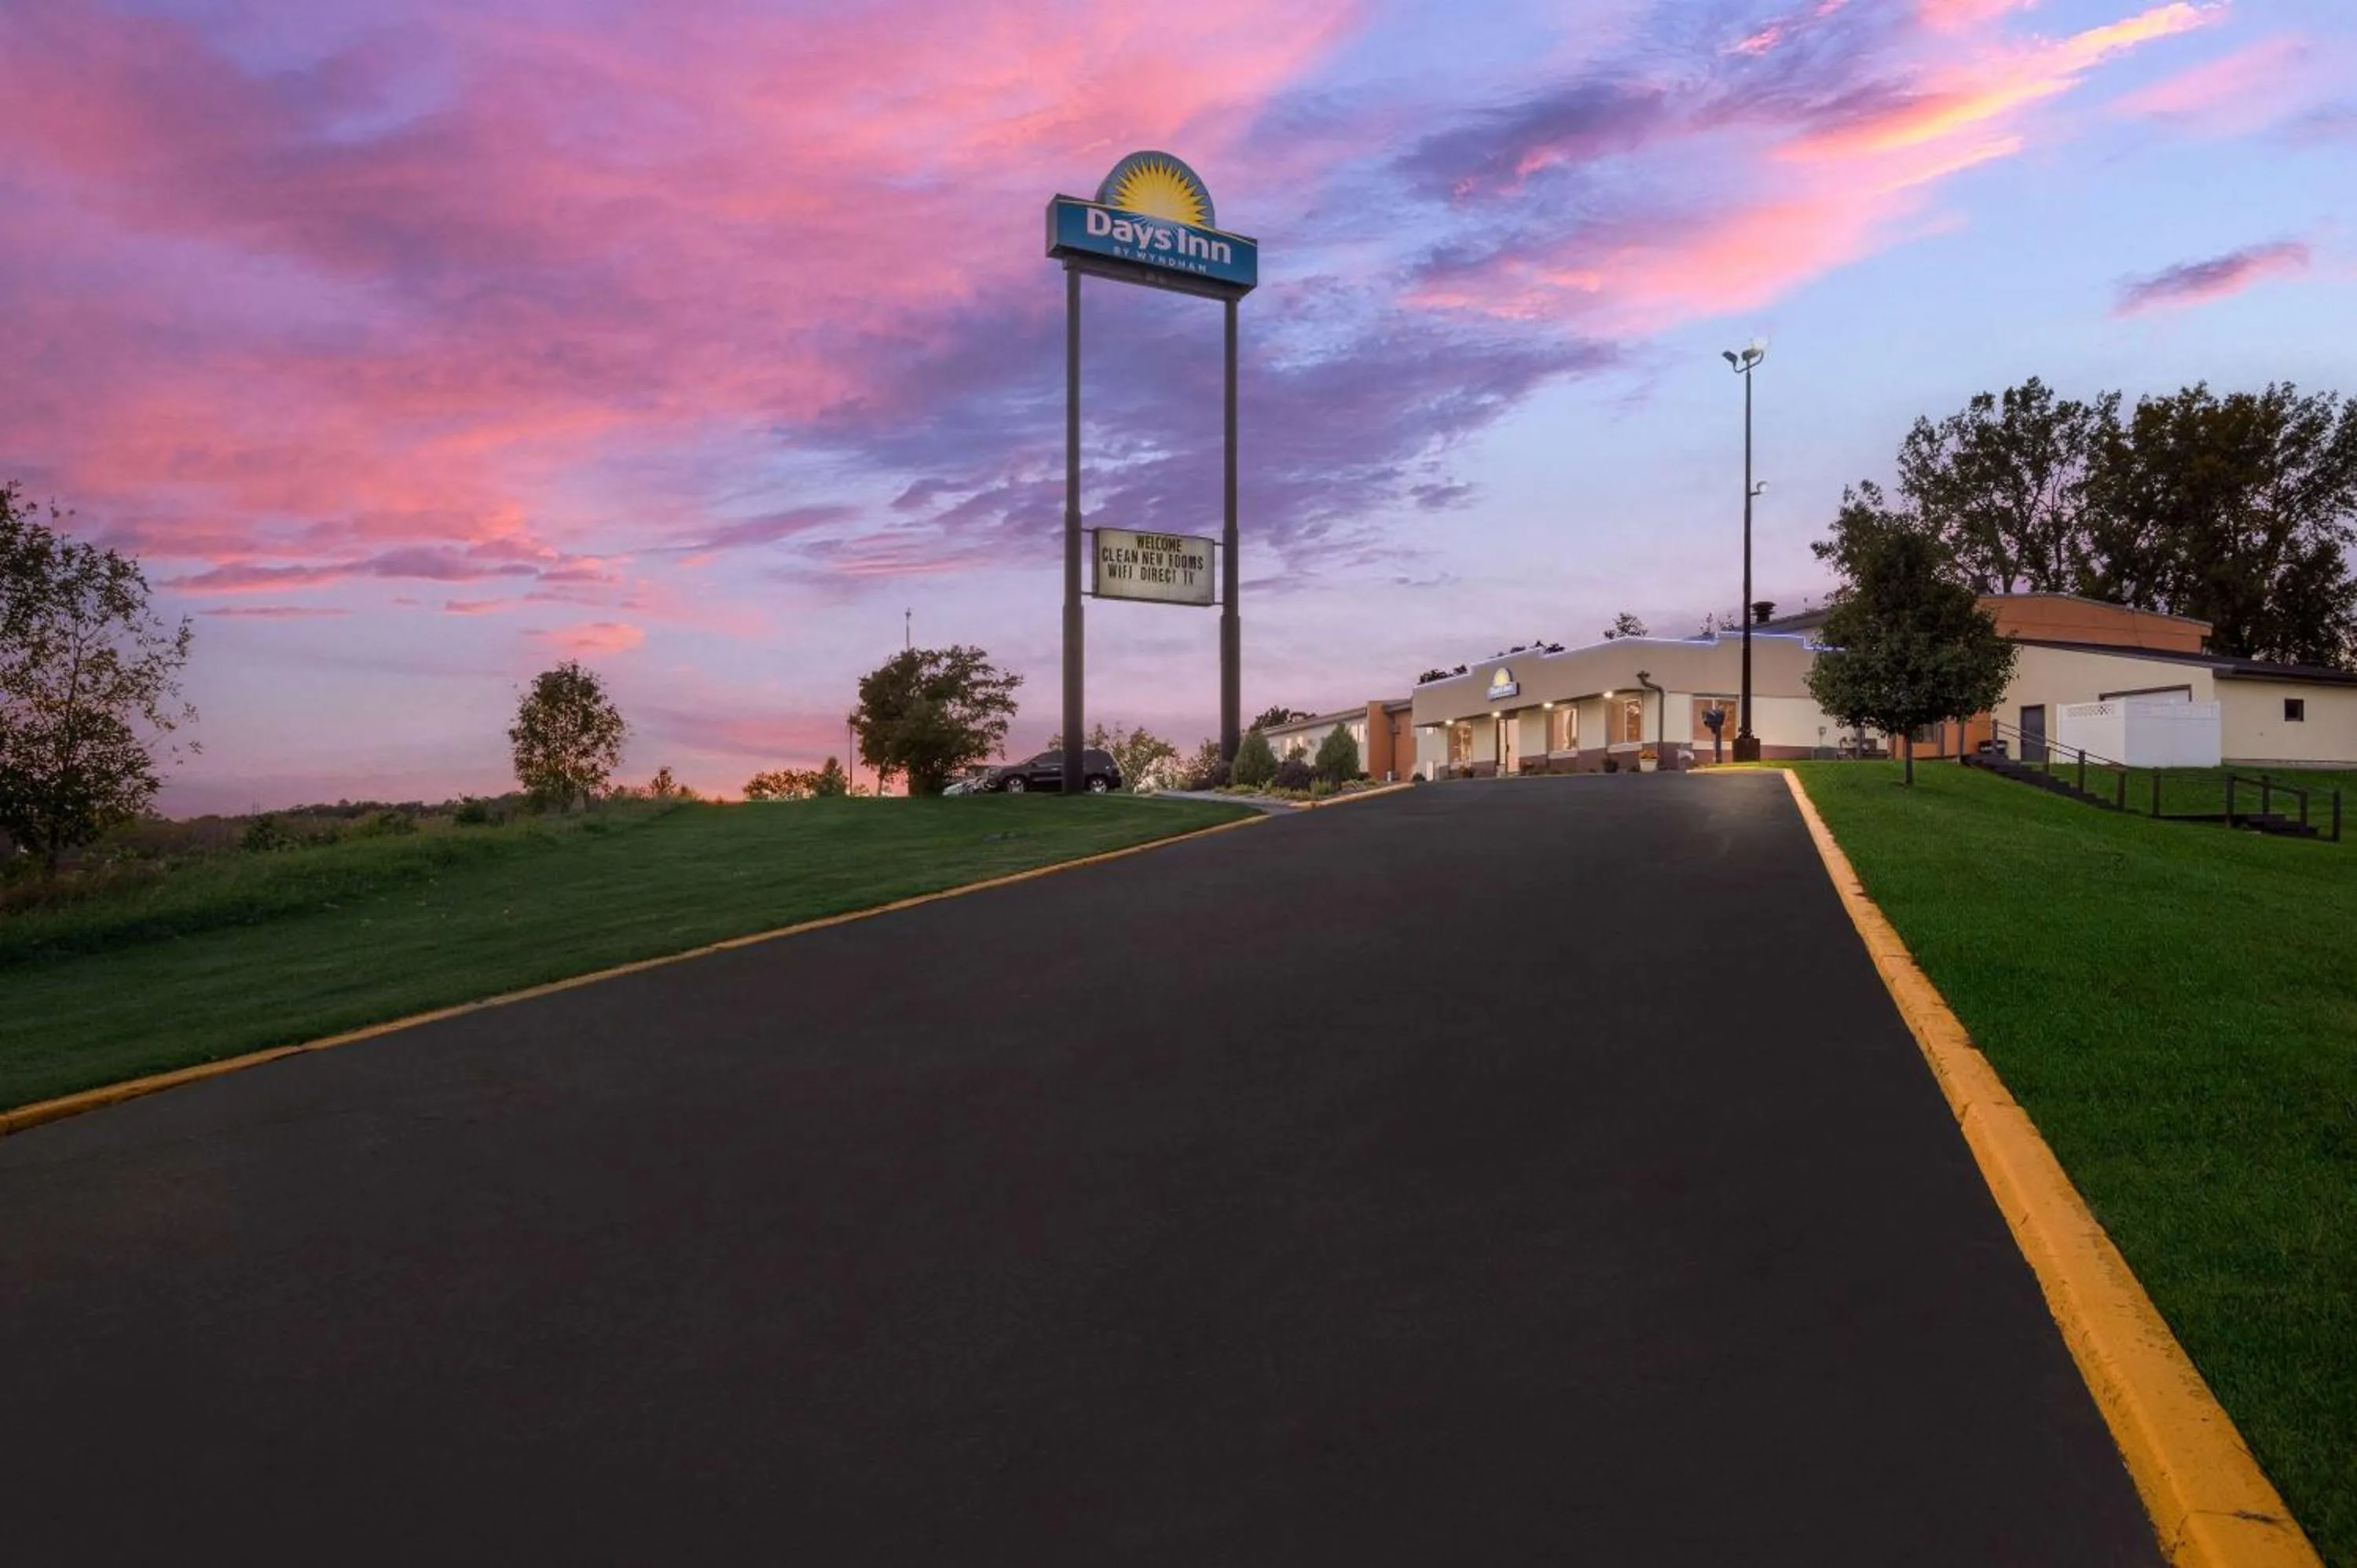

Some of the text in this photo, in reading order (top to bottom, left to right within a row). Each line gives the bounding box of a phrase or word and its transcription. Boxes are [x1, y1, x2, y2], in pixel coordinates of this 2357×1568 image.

[1087, 207, 1231, 265] Days Inn
[1113, 246, 1206, 273] BY WYNDHAM
[1135, 536, 1182, 552] WELCOME
[1102, 547, 1204, 570] CLEAN NEW ROOMS
[1108, 564, 1132, 579] WIFI
[1141, 567, 1176, 584] DIRECT
